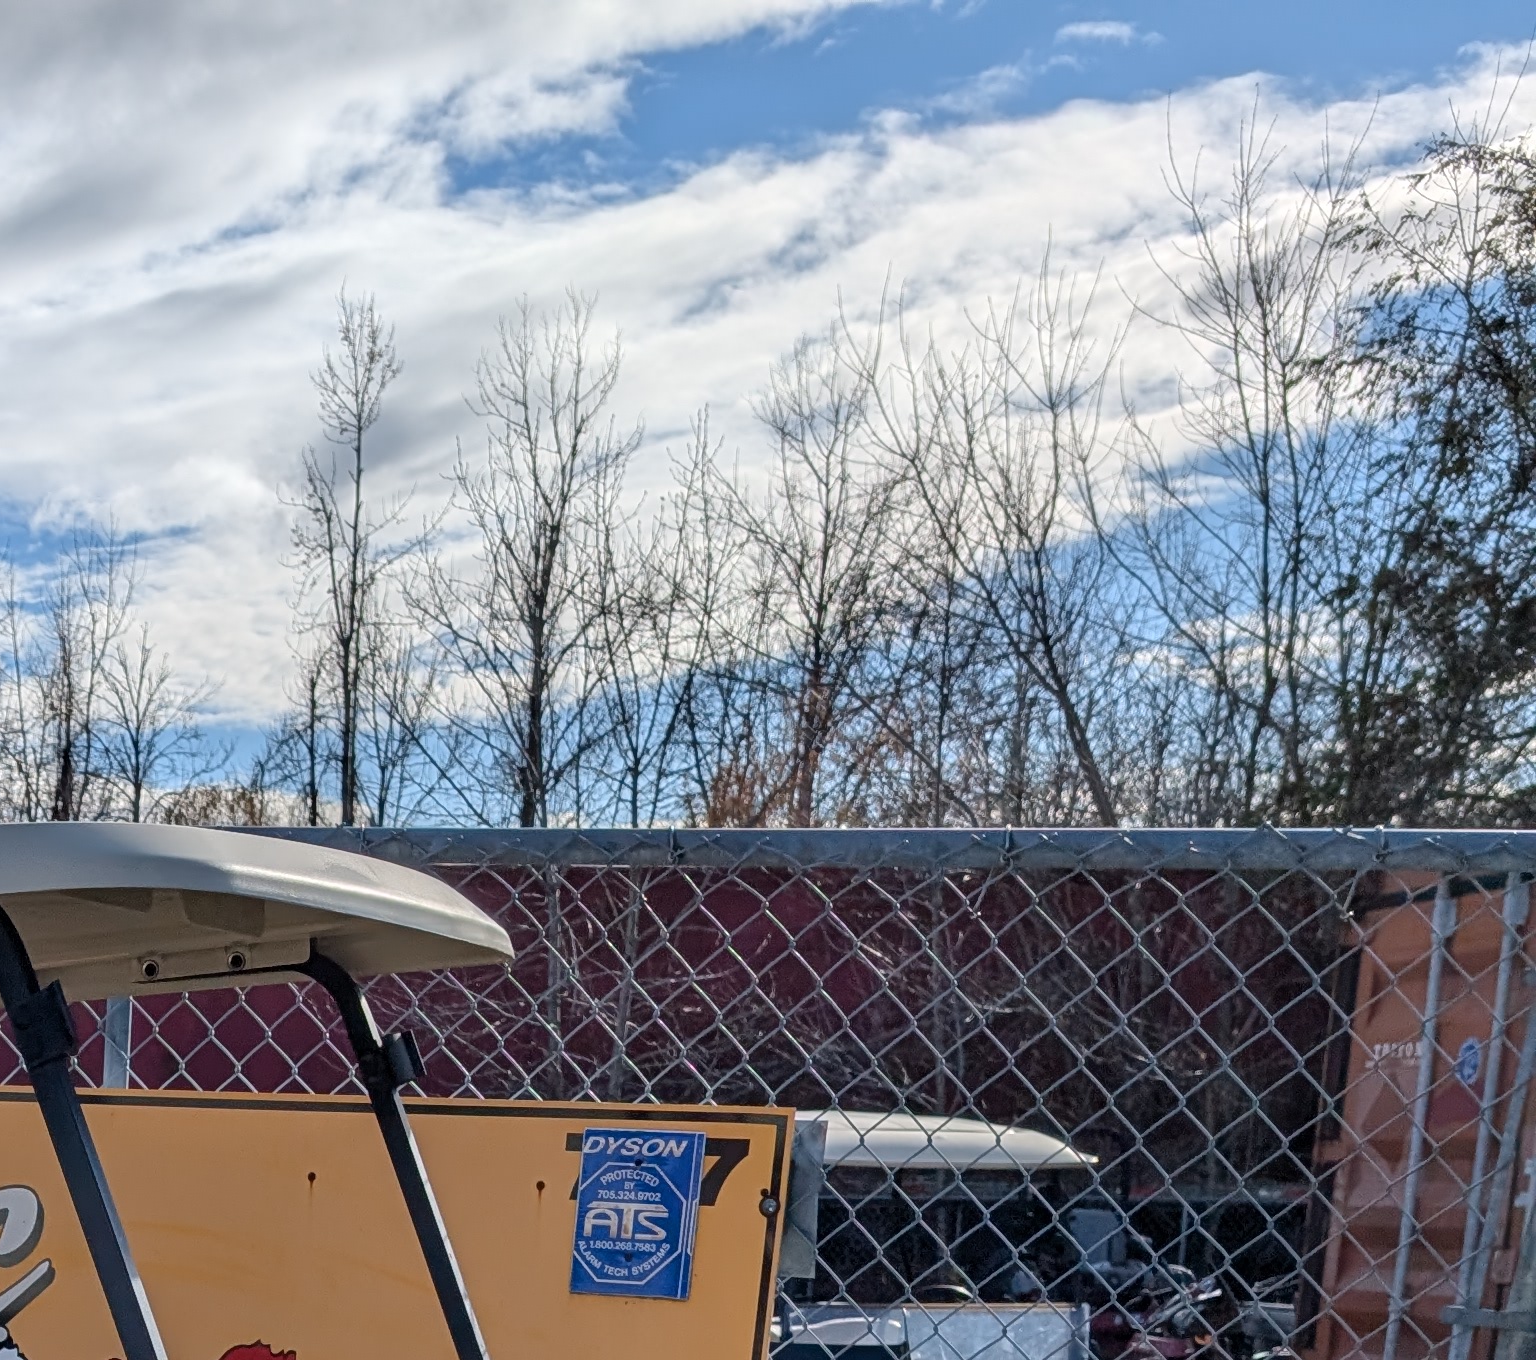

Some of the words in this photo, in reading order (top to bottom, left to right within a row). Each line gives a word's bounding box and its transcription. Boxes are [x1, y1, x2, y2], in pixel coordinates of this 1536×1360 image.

[583, 1136, 689, 1158] DYSON
[599, 1169, 660, 1188] PROTECTED
[624, 1182, 636, 1190] BY
[583, 1201, 669, 1241] ATS
[578, 1240, 602, 1269] ALARM
[604, 1264, 629, 1277] TECH
[631, 1242, 671, 1276] SYSTEMS
